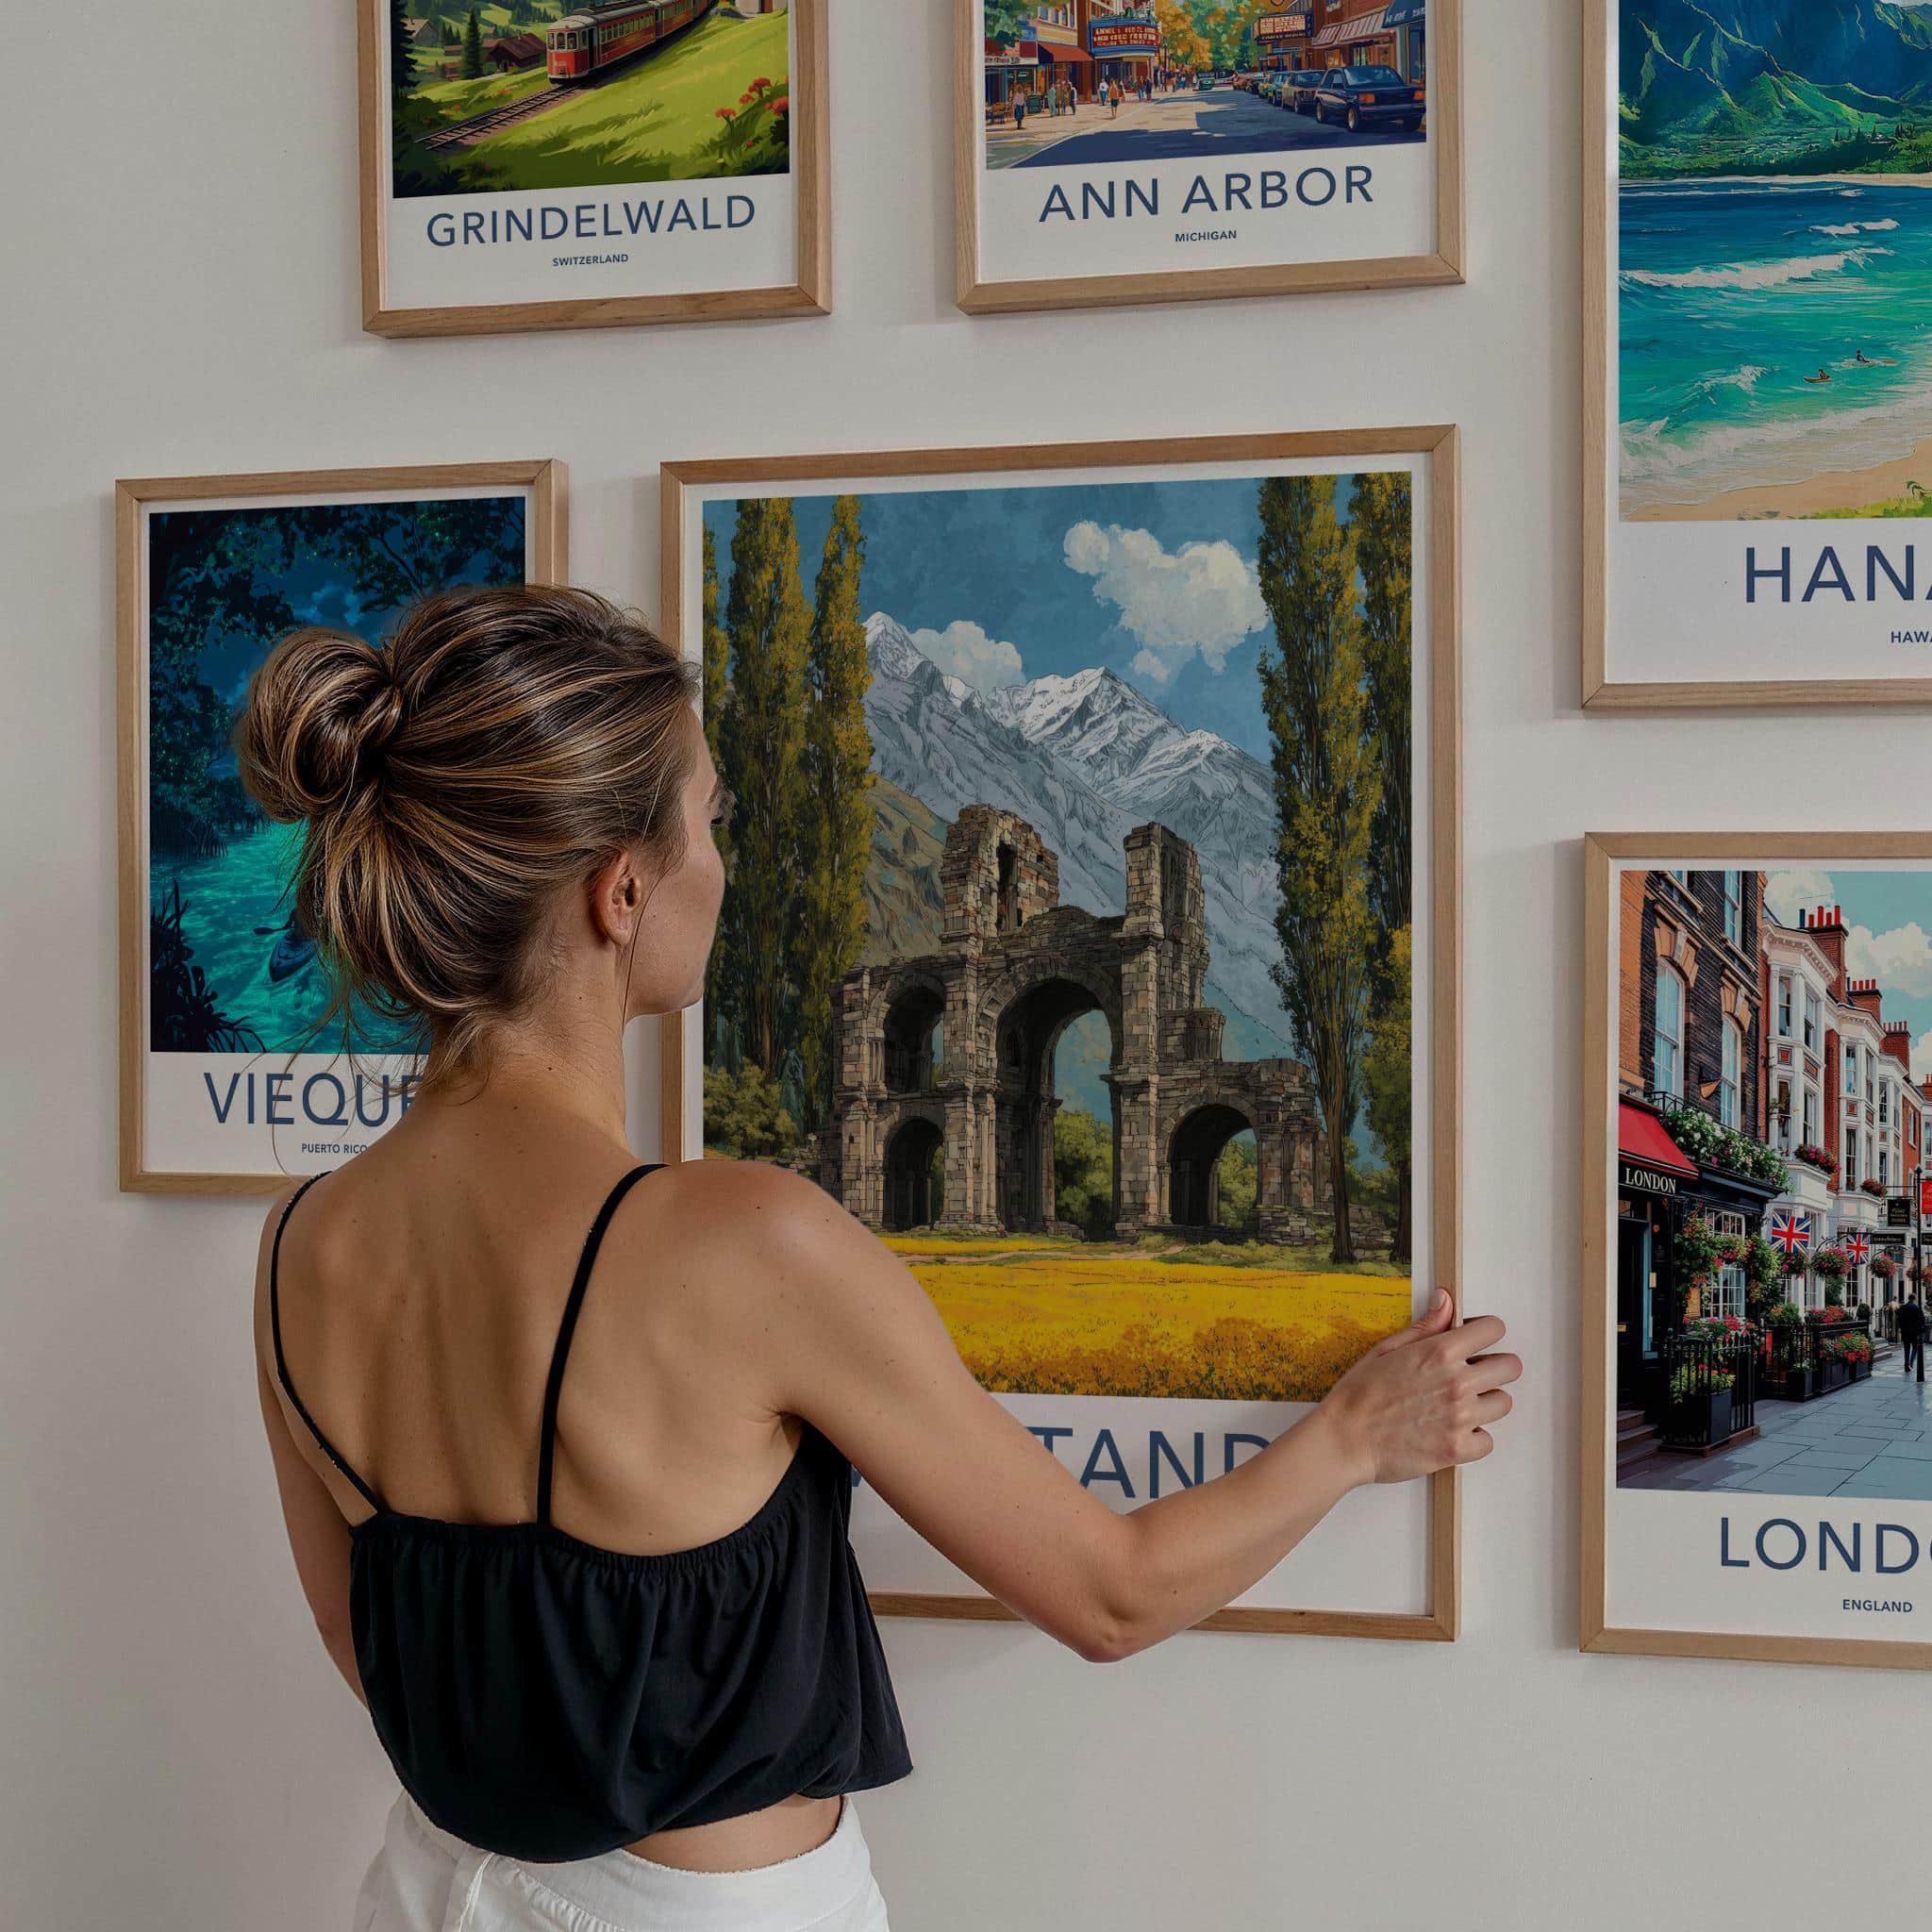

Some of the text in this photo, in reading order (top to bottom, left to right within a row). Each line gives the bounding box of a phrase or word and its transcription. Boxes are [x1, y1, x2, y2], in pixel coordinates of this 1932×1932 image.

[1039, 165, 1374, 223] ANN ARBOR
[427, 194, 756, 247] GRINDELWALD
[1175, 229, 1238, 242] MICHIGAN
[552, 254, 629, 267] SWITZERLAND
[1746, 544, 1932, 604] HAN
[1890, 631, 1932, 643] HAW
[302, 1143, 341, 1154] PUERTO
[1625, 1167, 1676, 1194] LONDON
[1721, 1516, 1932, 1574] LOND
[1842, 1598, 1913, 1614] ENGLAND
